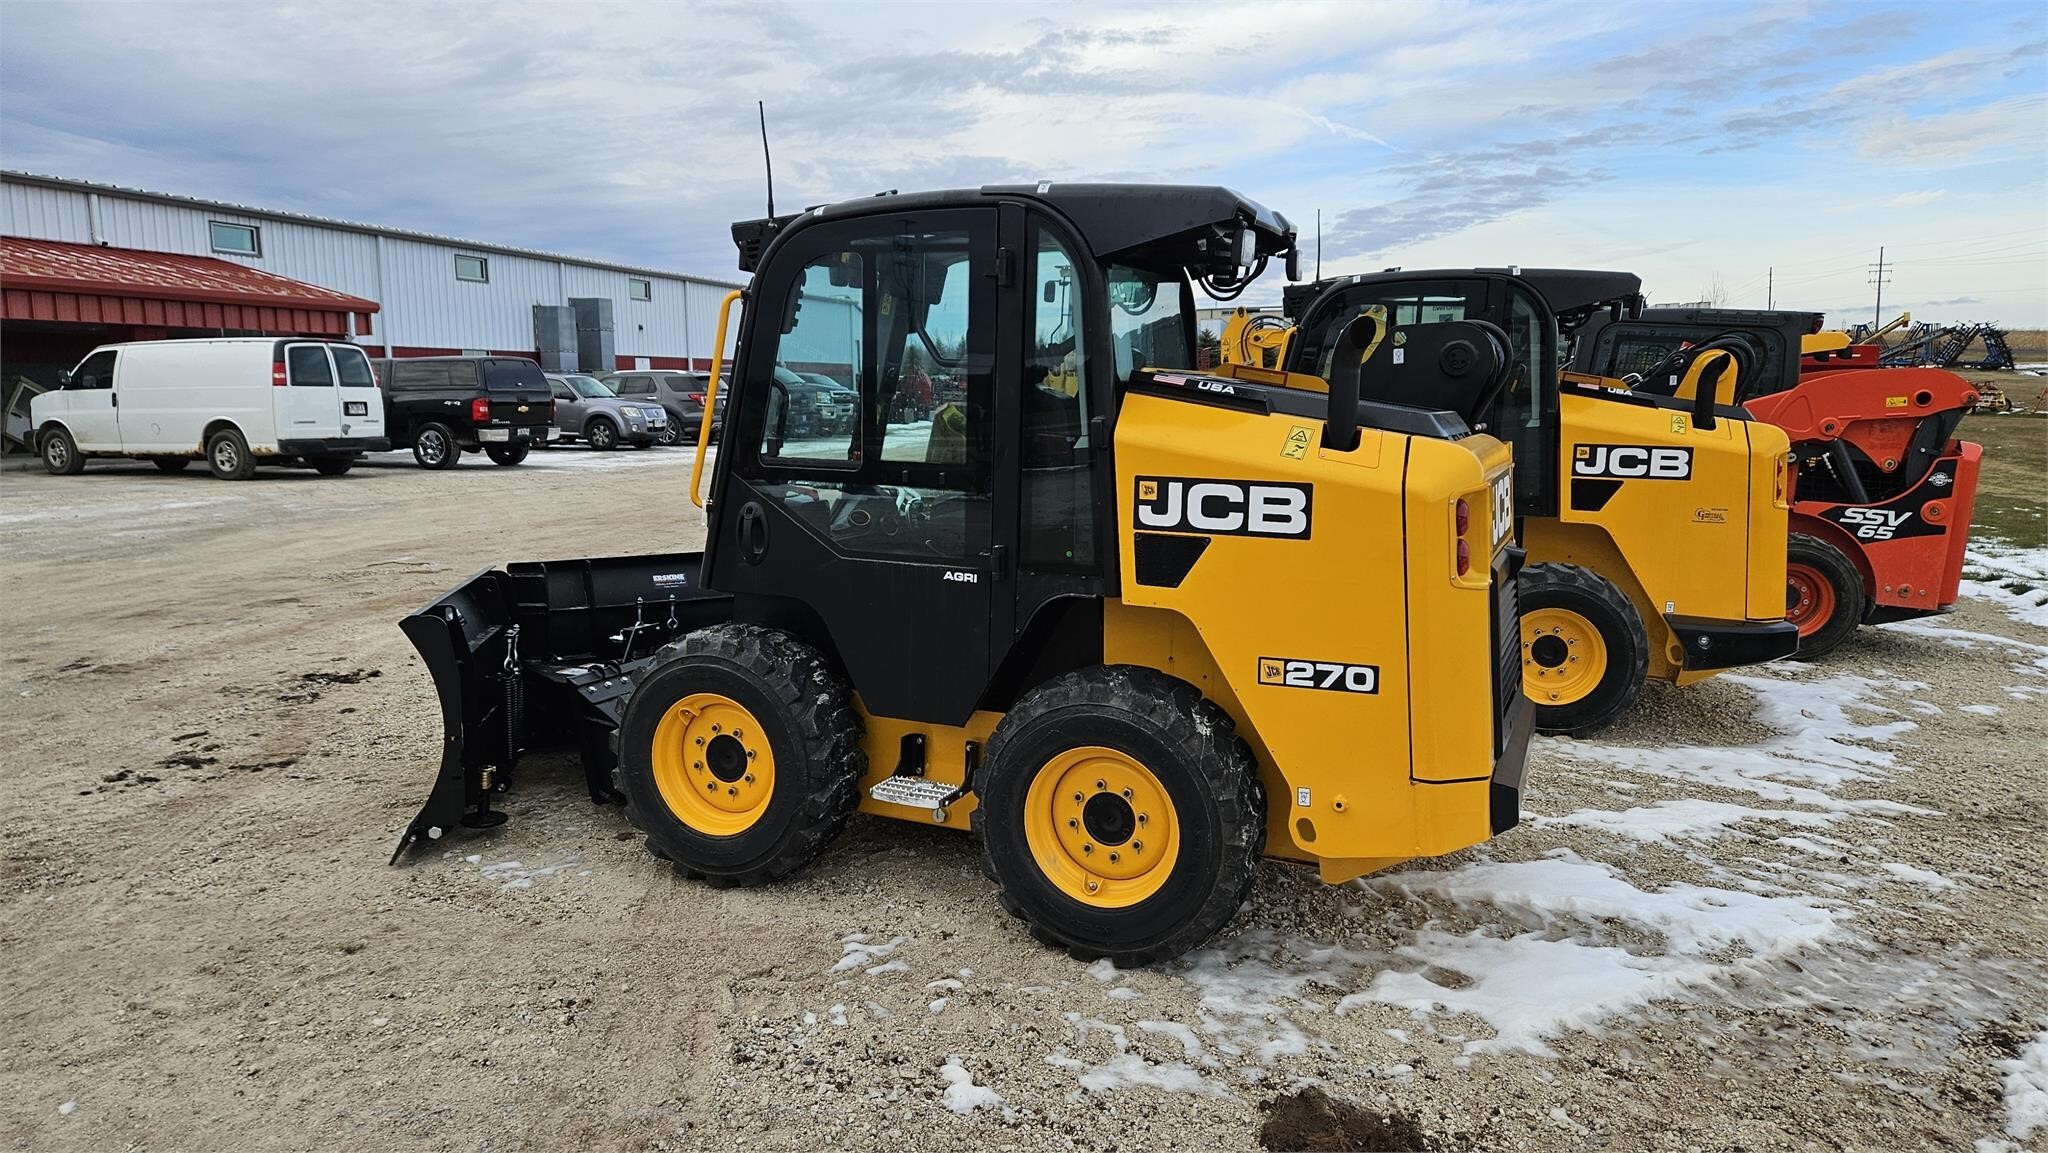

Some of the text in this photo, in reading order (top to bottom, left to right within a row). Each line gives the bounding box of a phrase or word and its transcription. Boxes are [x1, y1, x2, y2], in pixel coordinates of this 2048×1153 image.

[1198, 381, 1235, 395] USA
[1575, 447, 1690, 478] JCB
[1138, 482, 1307, 534] JCB
[1493, 475, 1511, 546] JCB
[1839, 507, 1913, 526] SSV
[1857, 525, 1897, 539] 65
[943, 571, 978, 583] AGRI
[1285, 661, 1375, 692] 270
